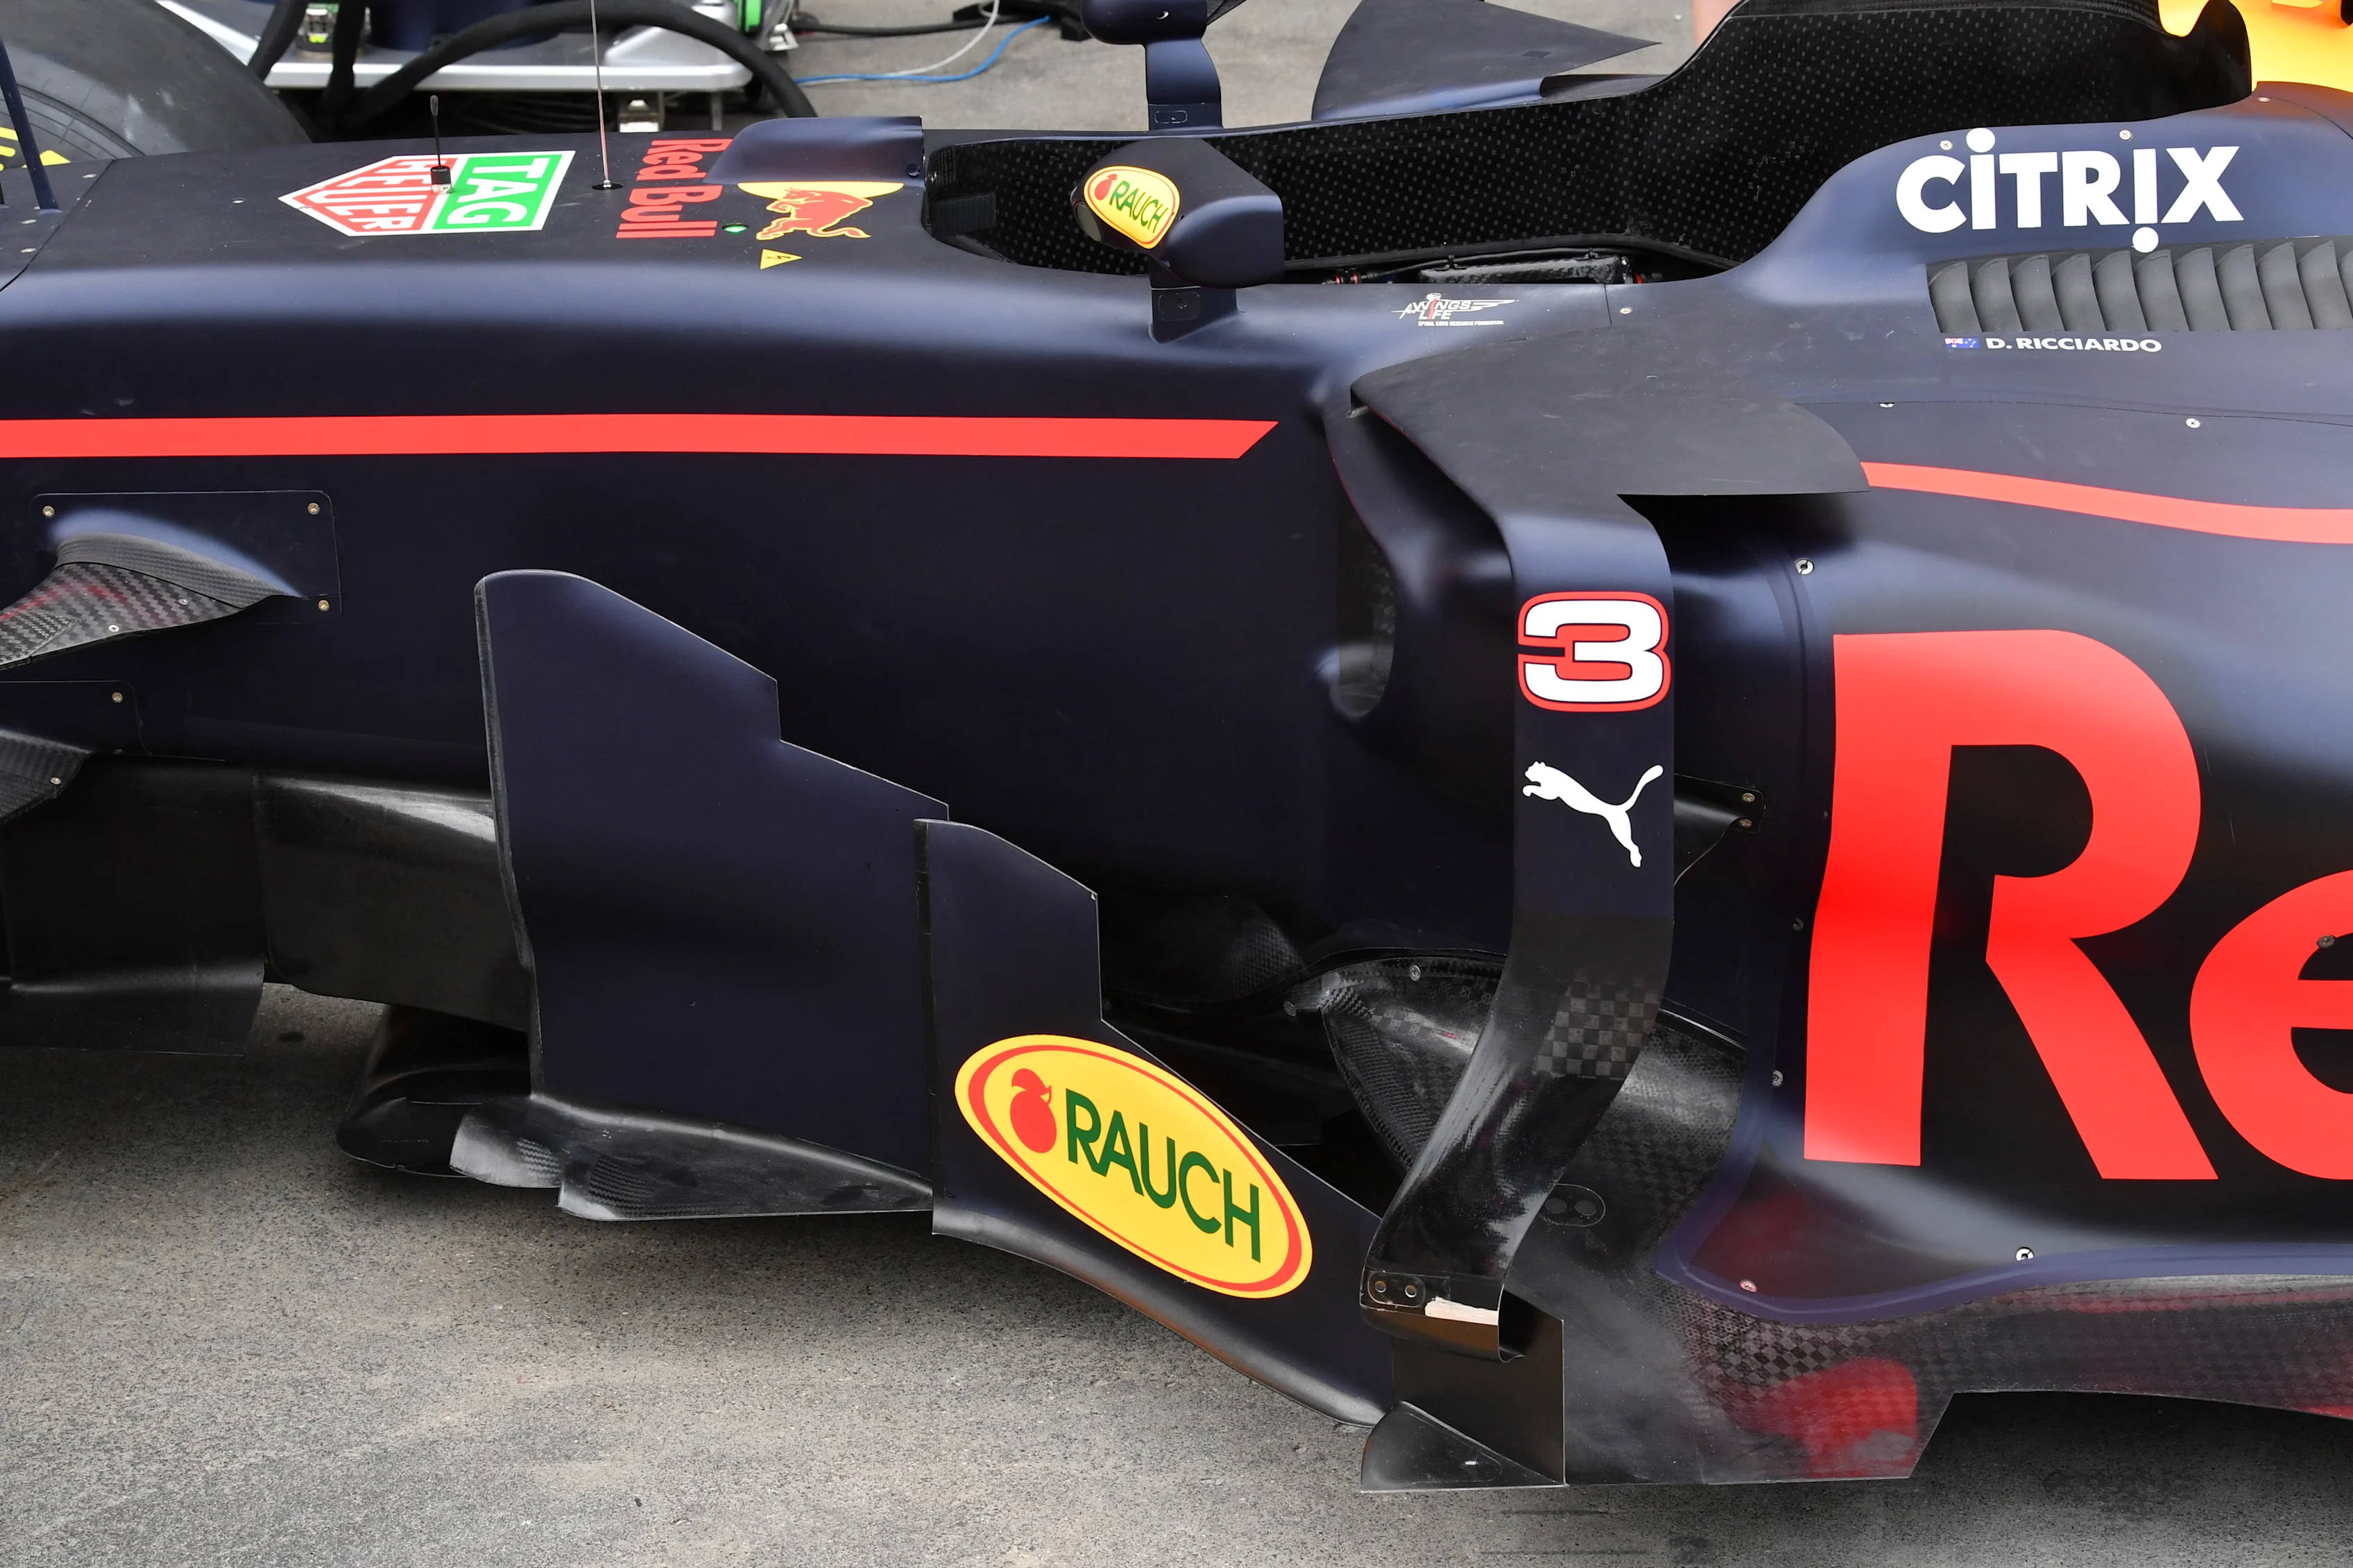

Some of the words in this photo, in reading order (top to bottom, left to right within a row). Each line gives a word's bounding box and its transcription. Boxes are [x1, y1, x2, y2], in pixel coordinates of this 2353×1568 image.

[636, 139, 733, 181] Red
[307, 158, 447, 230] HEUER
[447, 157, 550, 225] TAG
[617, 185, 724, 239] Bull
[1109, 180, 1169, 234] RAUCH
[1412, 299, 1472, 311] WINGS
[1418, 310, 1452, 320] LIFE
[1985, 338, 2012, 349] D.
[2016, 338, 2162, 352] RICCIARDO
[1518, 591, 1672, 712] 3
[1066, 1088, 1260, 1263] RAUCH
